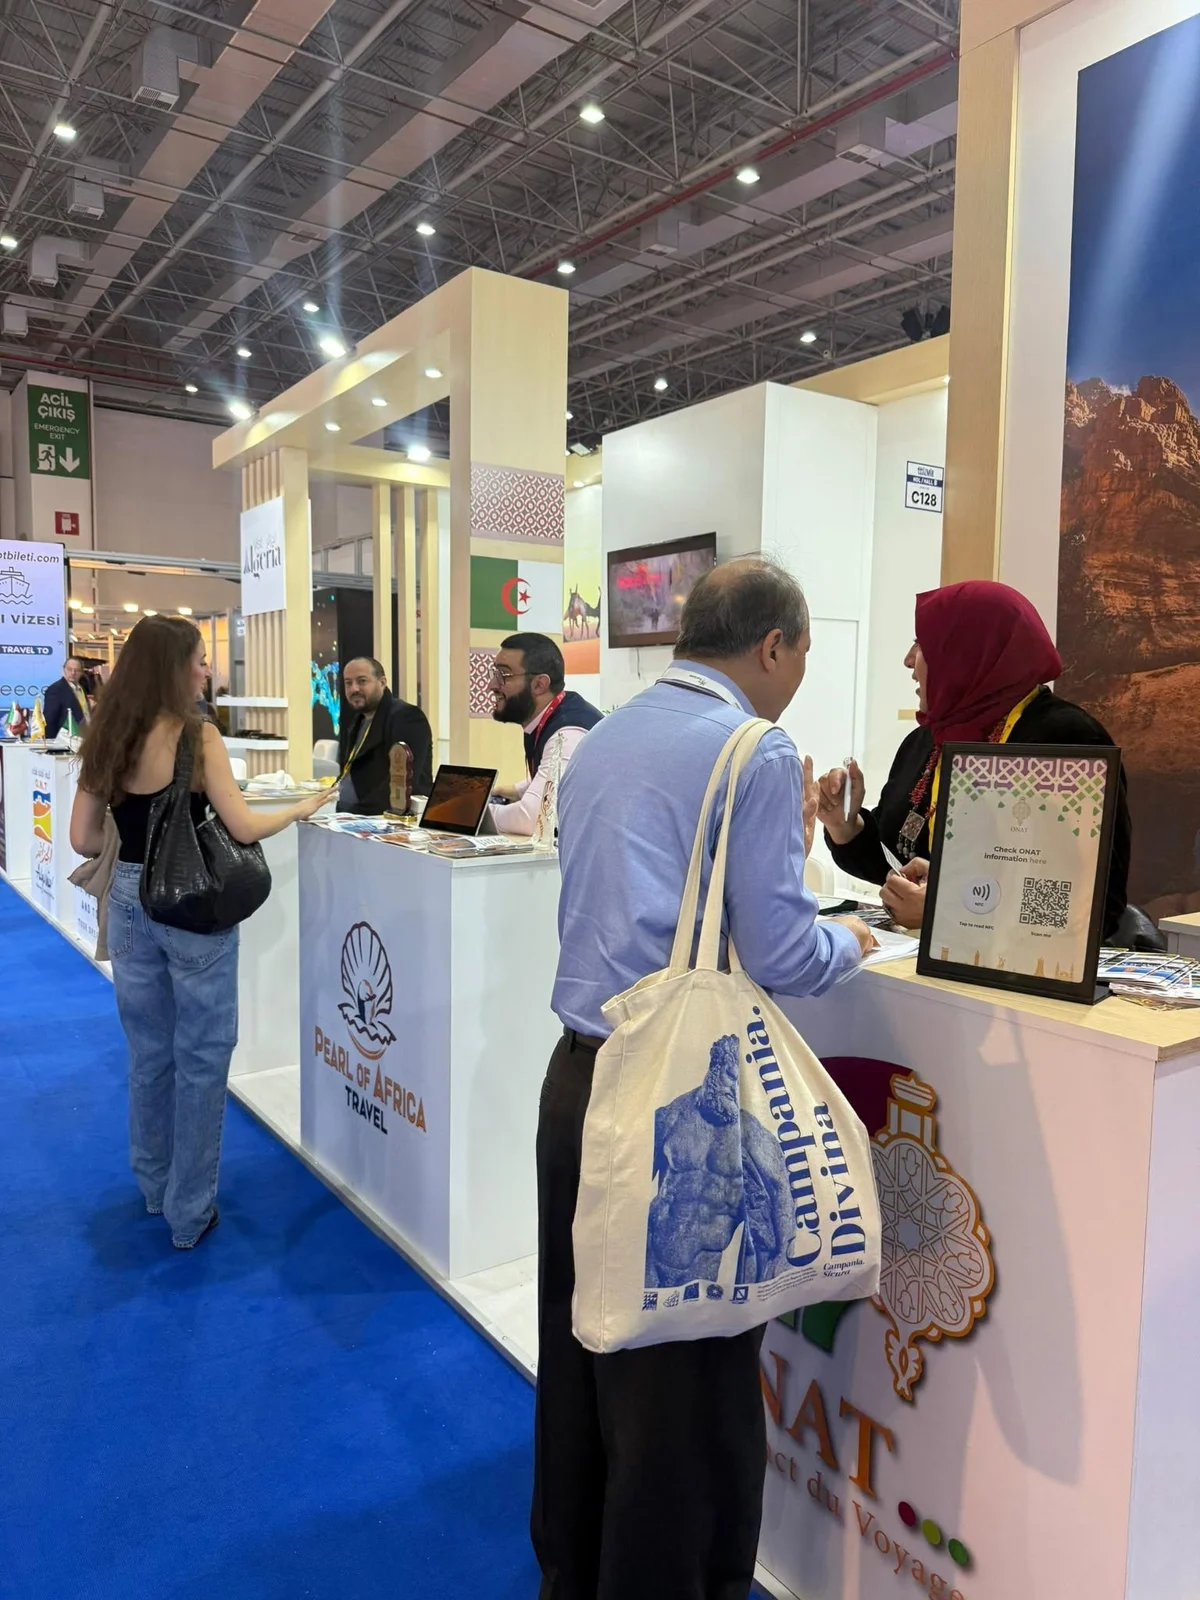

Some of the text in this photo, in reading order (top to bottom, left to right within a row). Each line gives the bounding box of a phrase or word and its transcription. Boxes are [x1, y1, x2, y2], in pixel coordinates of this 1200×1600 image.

[40, 392, 73, 407] ACİL
[38, 405, 76, 422] ÇIKIŞ
[34, 422, 80, 434] EMERGENCY
[50, 432, 65, 440] EXIT
[911, 490, 937, 507] C128
[11, 612, 60, 626] VİZESİ
[2, 646, 49, 655] TRAVEL TO
[984, 852, 1047, 865] information here
[994, 846, 1041, 856] Check ONAT
[314, 1025, 427, 1133] PEARL OF AFRICA
[345, 1085, 388, 1135] TRAVEL
[813, 1101, 866, 1259] Divina
[823, 1270, 850, 1278] Sicura
[760, 1350, 895, 1500] NAT
[806, 1471, 842, 1519] du
